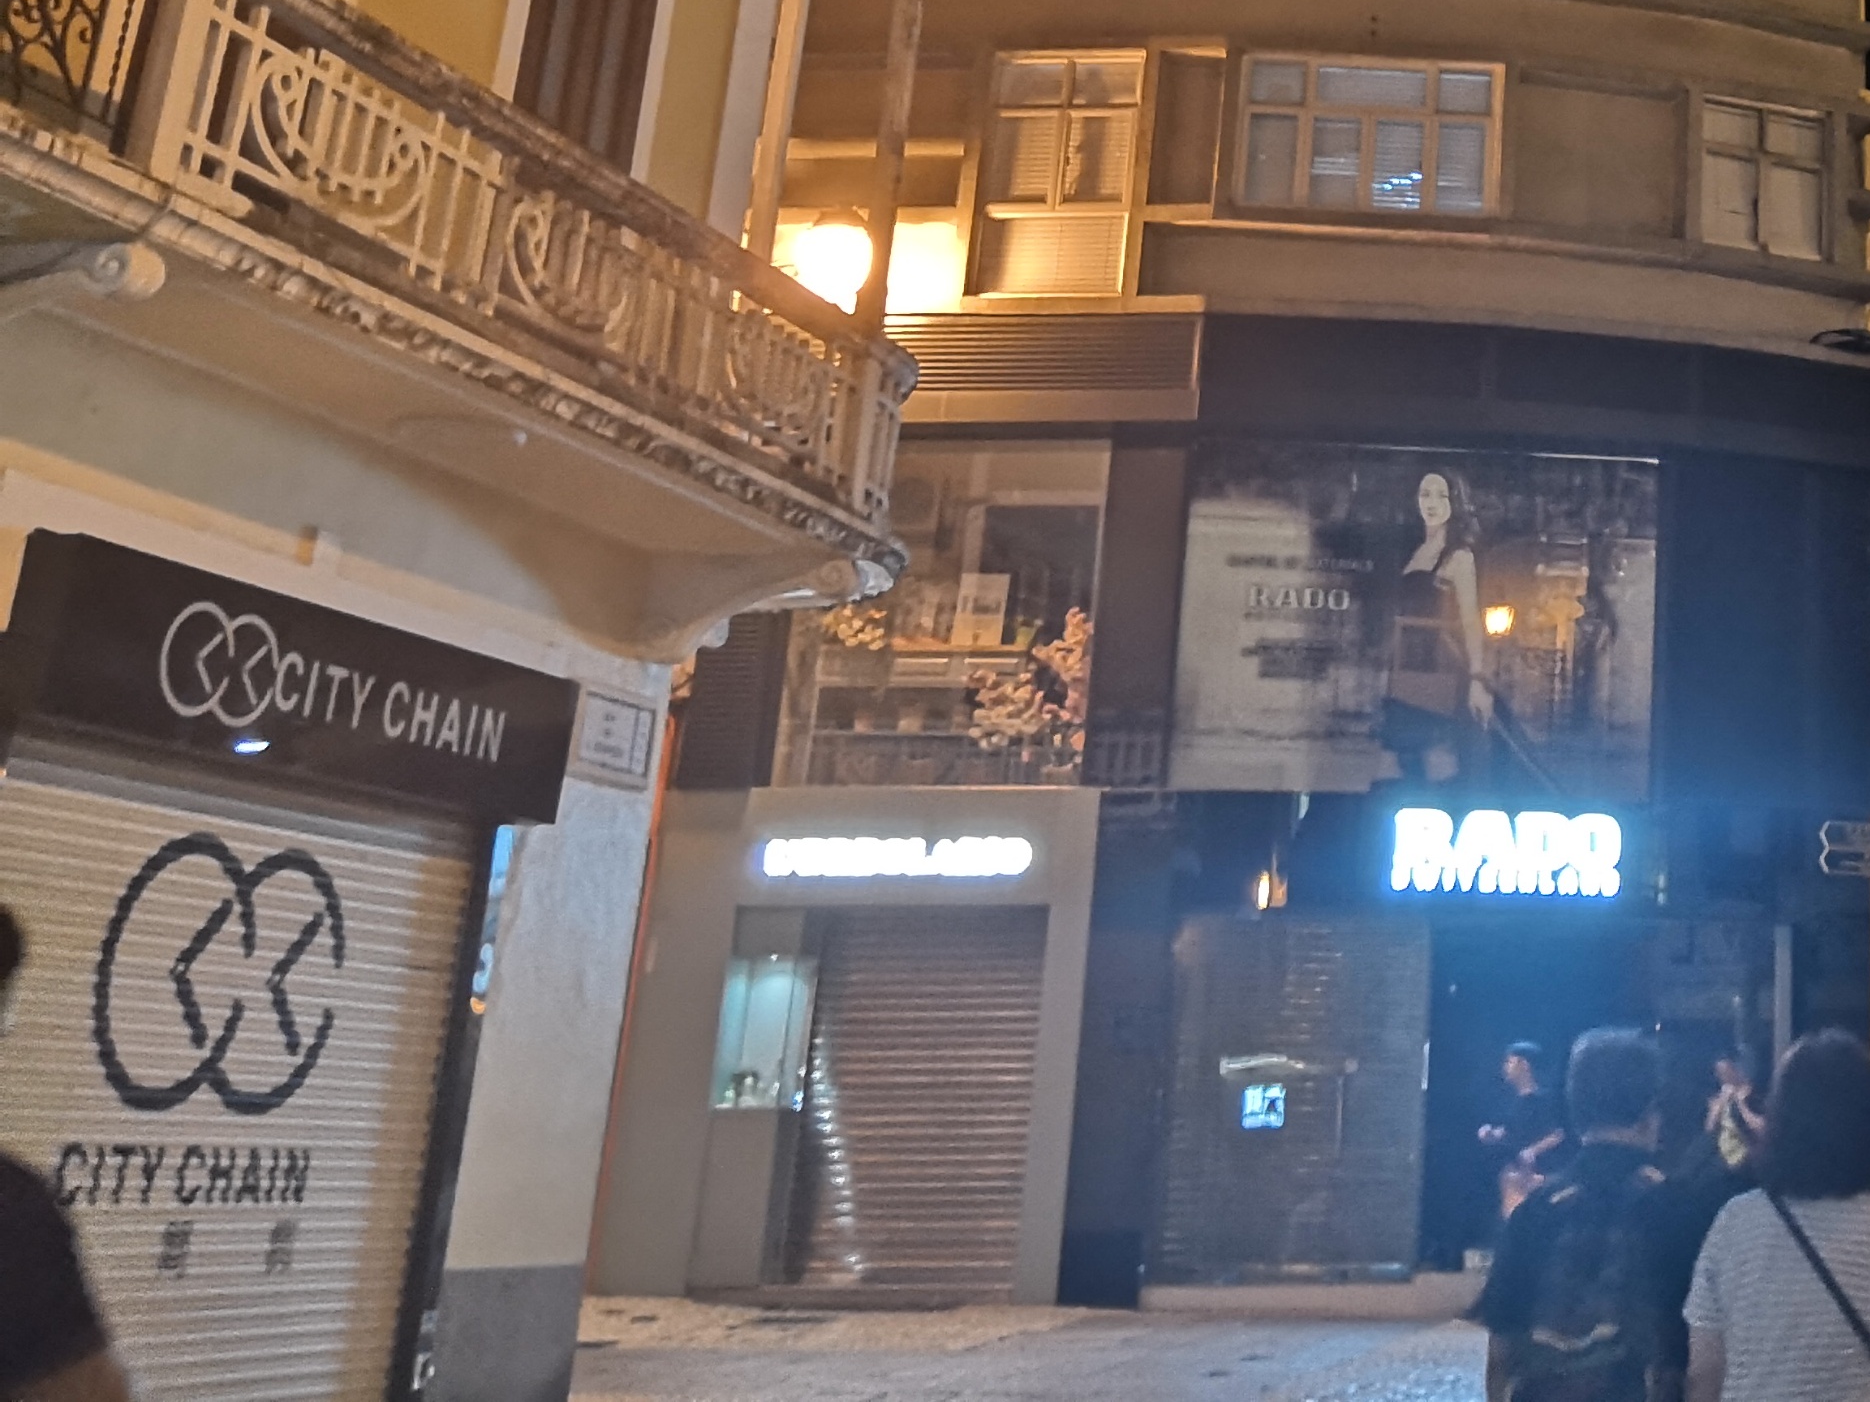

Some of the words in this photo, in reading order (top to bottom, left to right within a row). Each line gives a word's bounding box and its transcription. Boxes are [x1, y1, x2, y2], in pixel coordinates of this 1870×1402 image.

[1248, 585, 1351, 611] RADO
[274, 651, 376, 730] CITY
[383, 680, 506, 762] CHAIN
[56, 1141, 166, 1206] CITY
[175, 1143, 311, 1204] CHAIN
